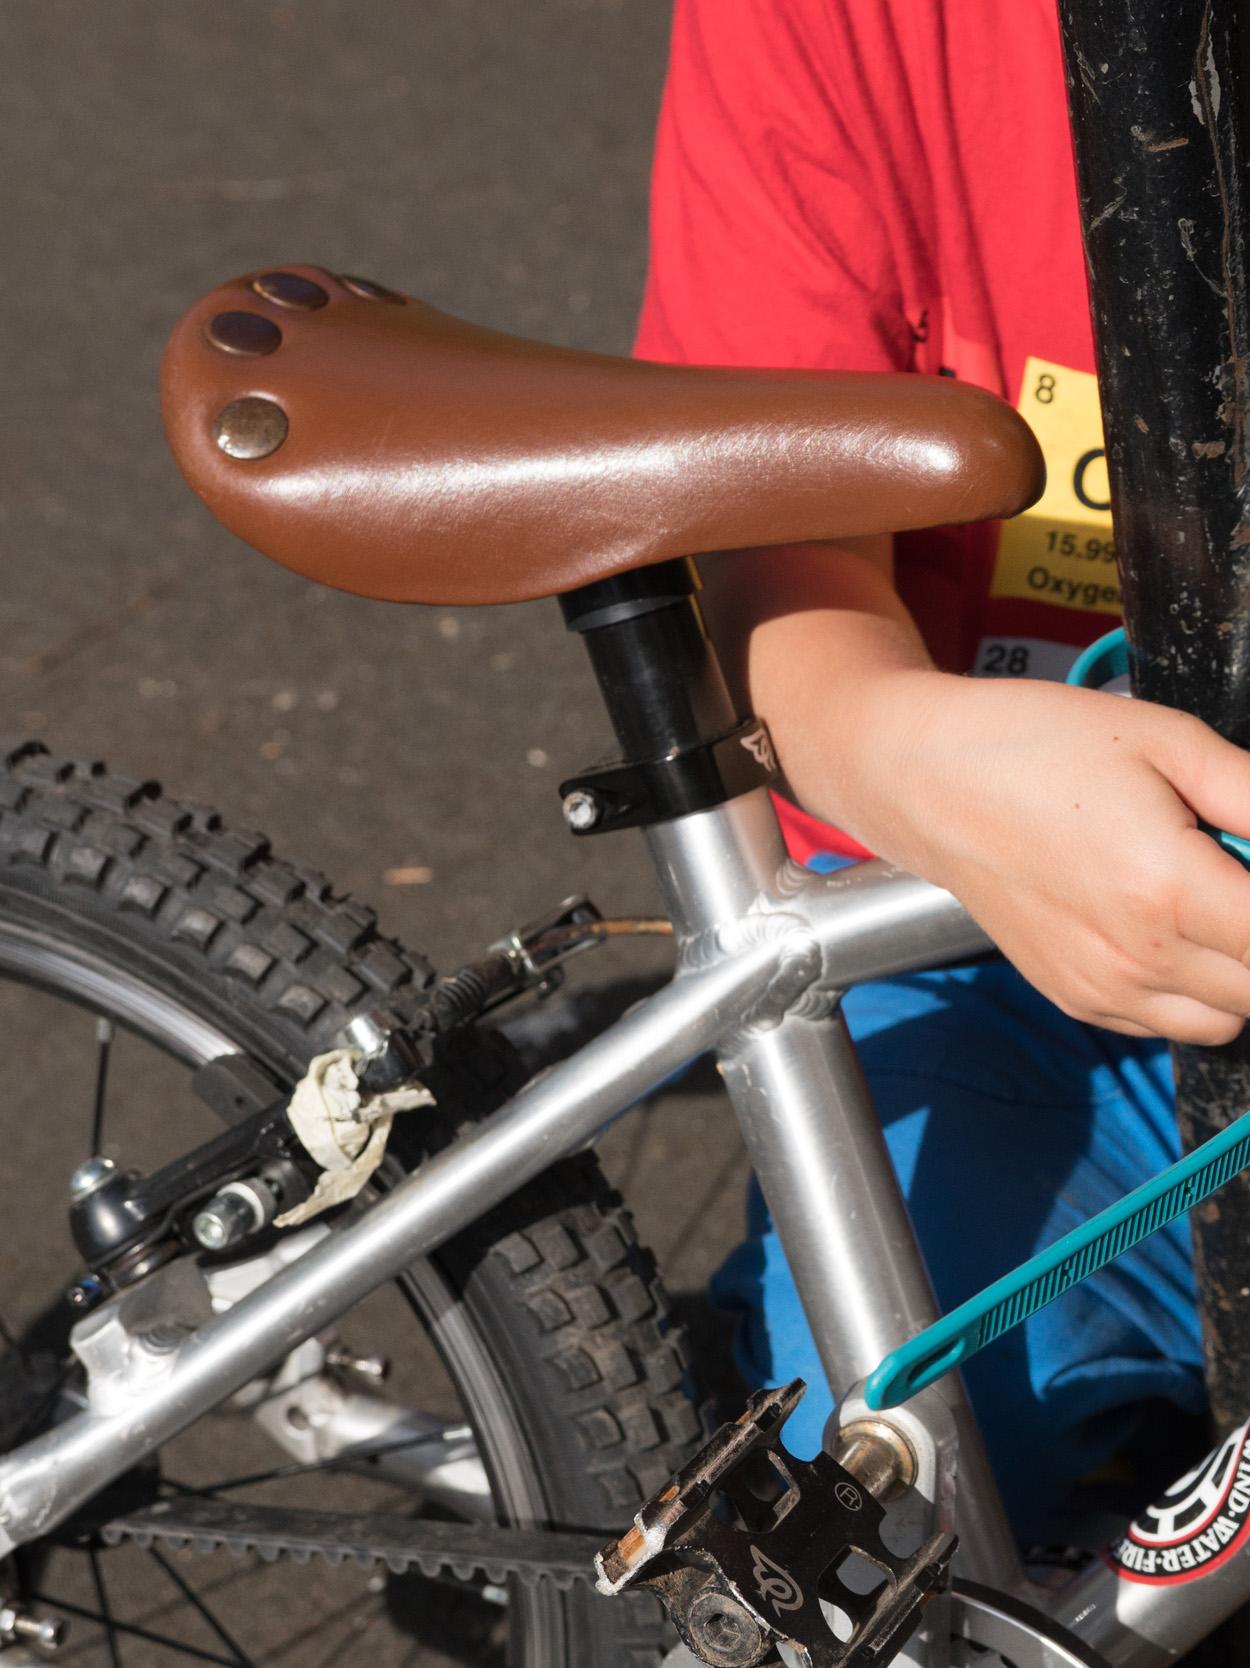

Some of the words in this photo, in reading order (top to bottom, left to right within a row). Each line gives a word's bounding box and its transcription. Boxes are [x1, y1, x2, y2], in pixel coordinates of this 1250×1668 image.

[1034, 374, 1056, 404] 8
[1027, 565, 1123, 604] Oxyge
[983, 644, 1029, 675] 28
